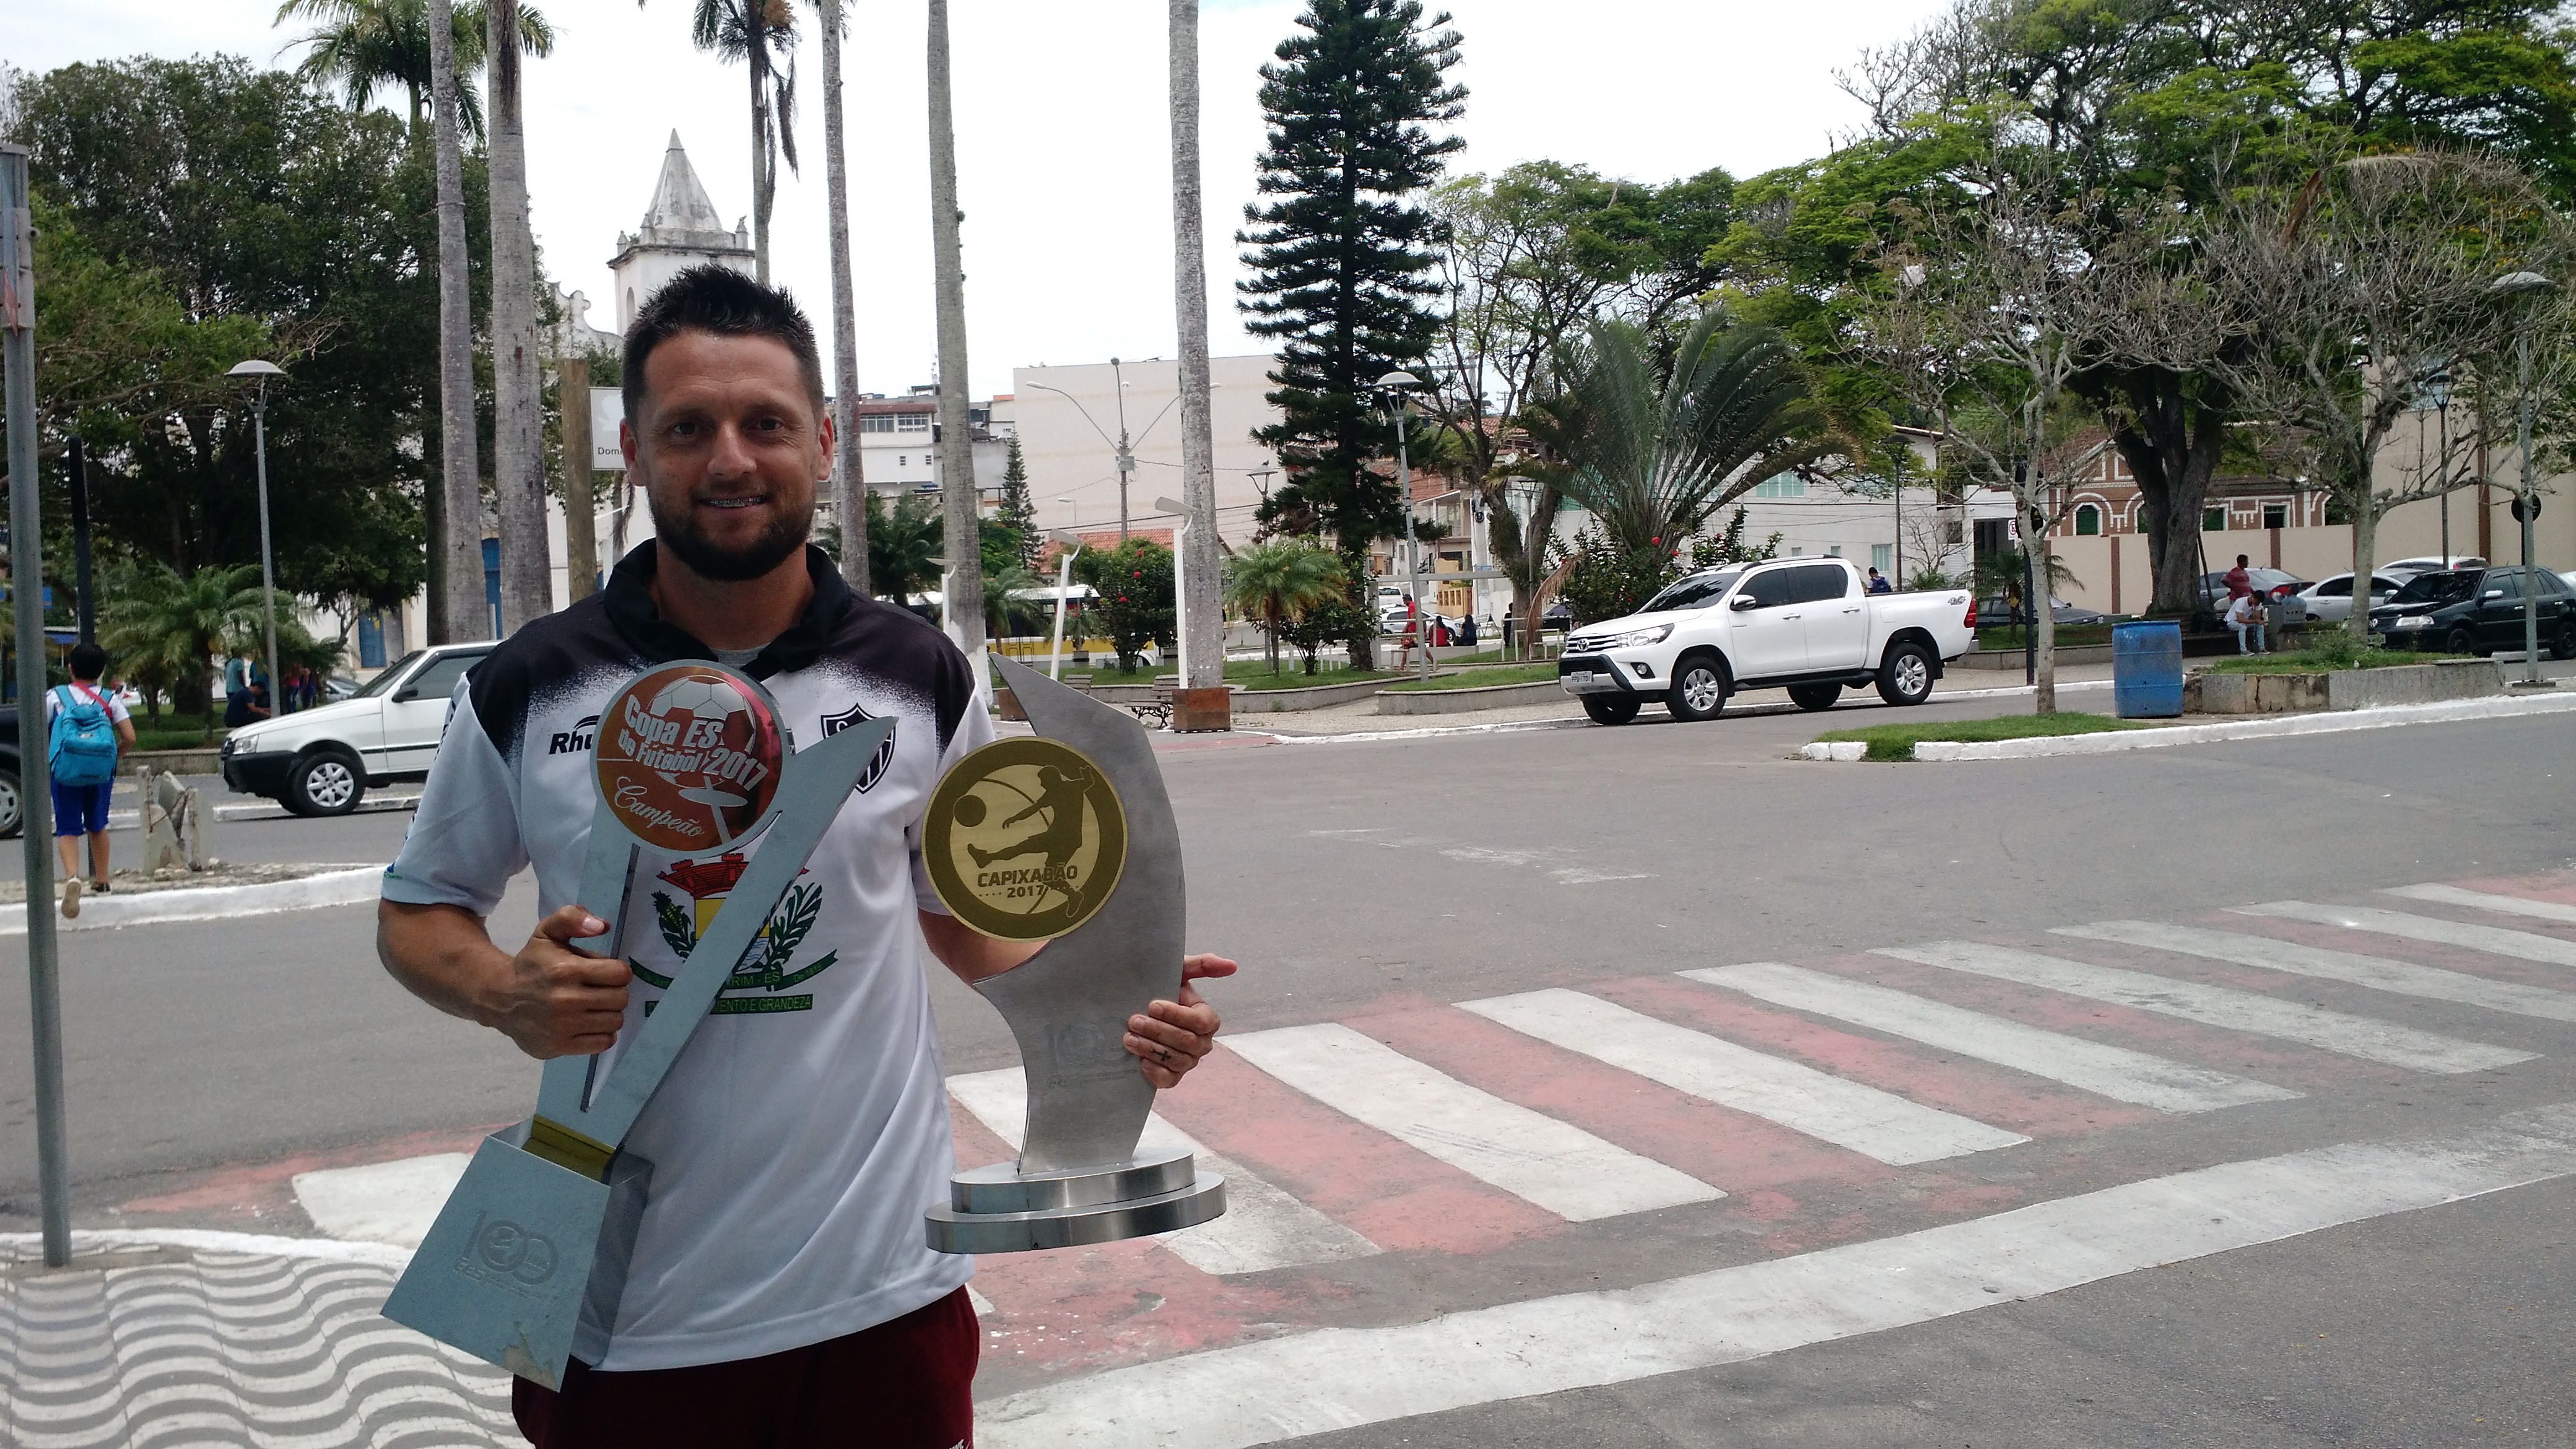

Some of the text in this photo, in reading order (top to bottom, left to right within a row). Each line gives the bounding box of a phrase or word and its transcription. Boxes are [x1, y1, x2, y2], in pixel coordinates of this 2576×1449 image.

[625, 694, 724, 748] Copa ES
[618, 729, 768, 791] de Futebol 2017
[614, 776, 705, 837] Campeão
[978, 862, 1078, 887] CAPIXABÃO
[1007, 885, 1045, 899] 2017
[765, 971, 780, 983] ES
[750, 999, 756, 1011] E
[759, 996, 811, 1011] GRANDEZA
